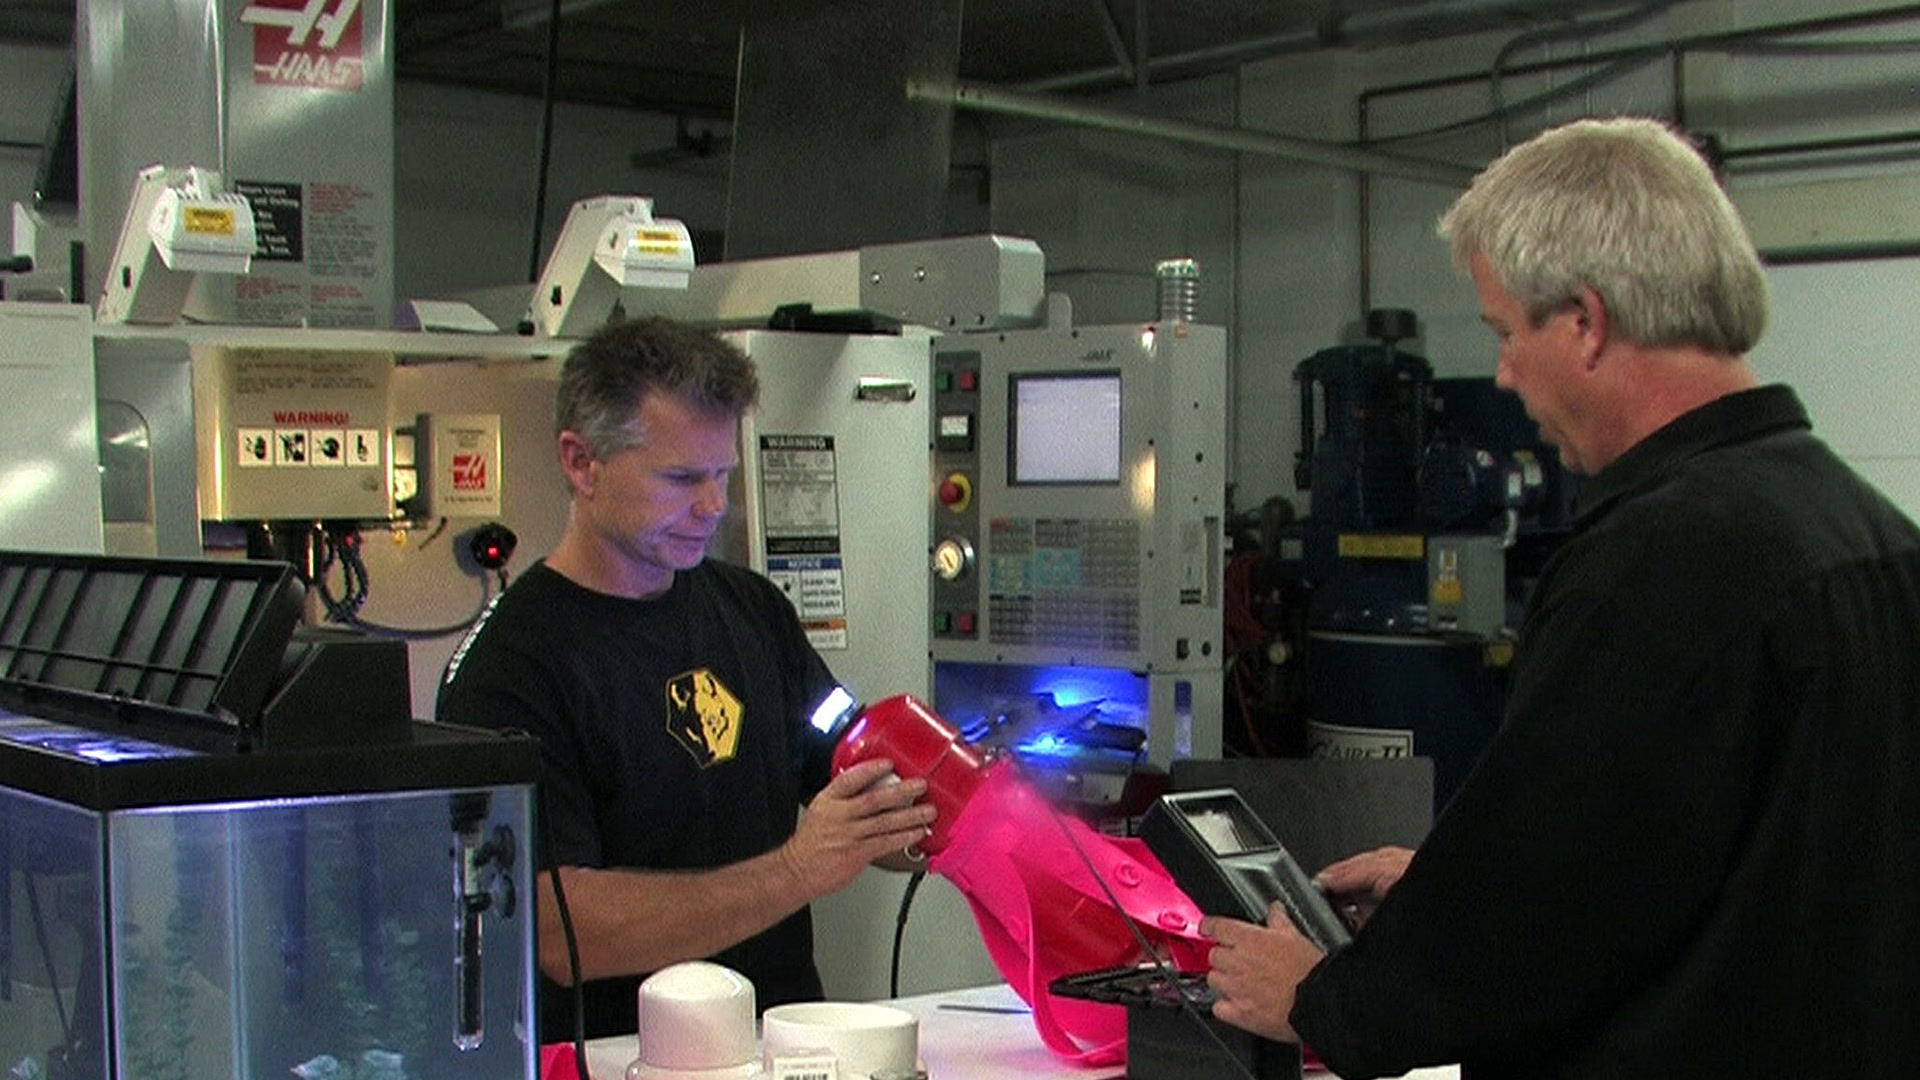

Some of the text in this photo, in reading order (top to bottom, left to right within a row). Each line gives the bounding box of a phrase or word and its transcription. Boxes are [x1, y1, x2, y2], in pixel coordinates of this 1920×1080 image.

[253, 51, 362, 84] HAAS
[273, 410, 350, 426] WARNING!
[766, 436, 827, 450] WARNING
